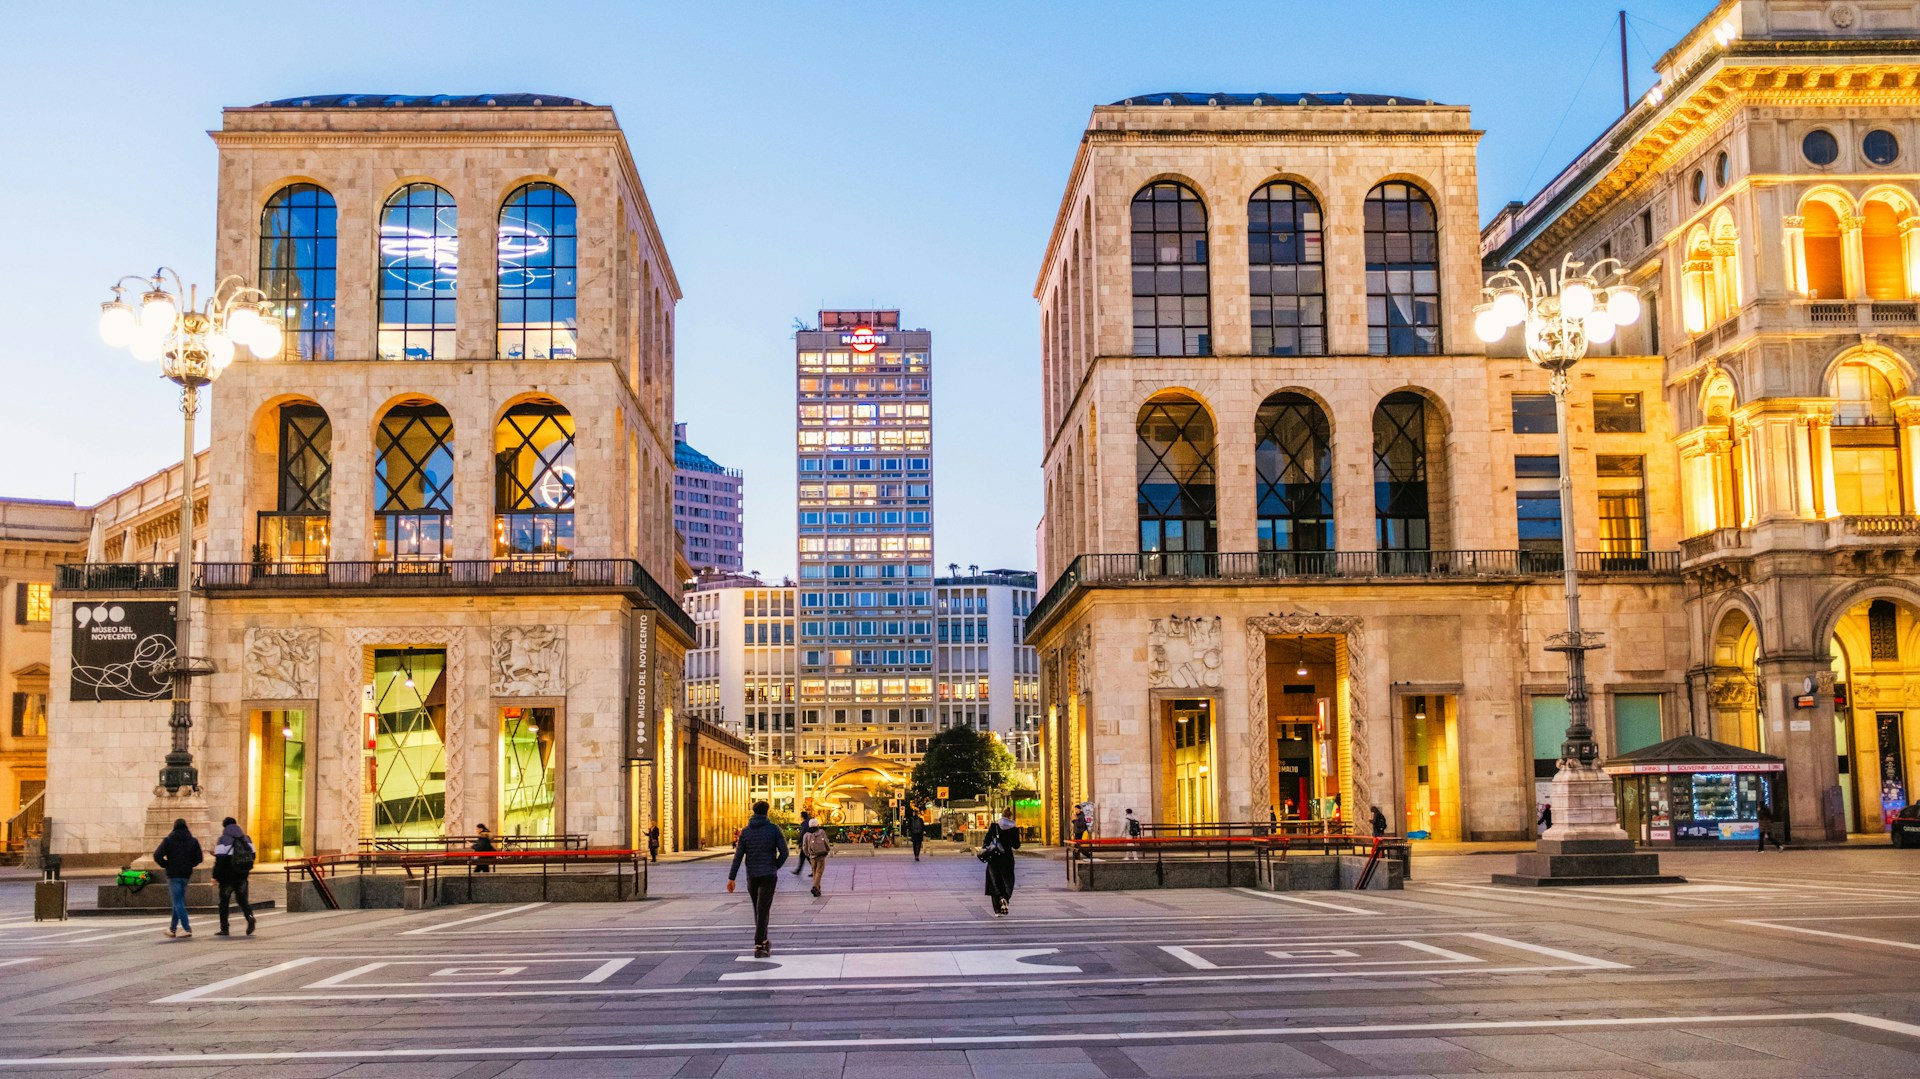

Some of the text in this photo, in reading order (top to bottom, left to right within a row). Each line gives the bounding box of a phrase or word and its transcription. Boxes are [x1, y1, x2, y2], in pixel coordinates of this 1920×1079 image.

[842, 335, 886, 343] MARTINI
[76, 607, 125, 628] 900
[639, 614, 648, 668] NOVECENTO
[639, 670, 647, 686] DEL
[638, 688, 646, 719] MUSEO
